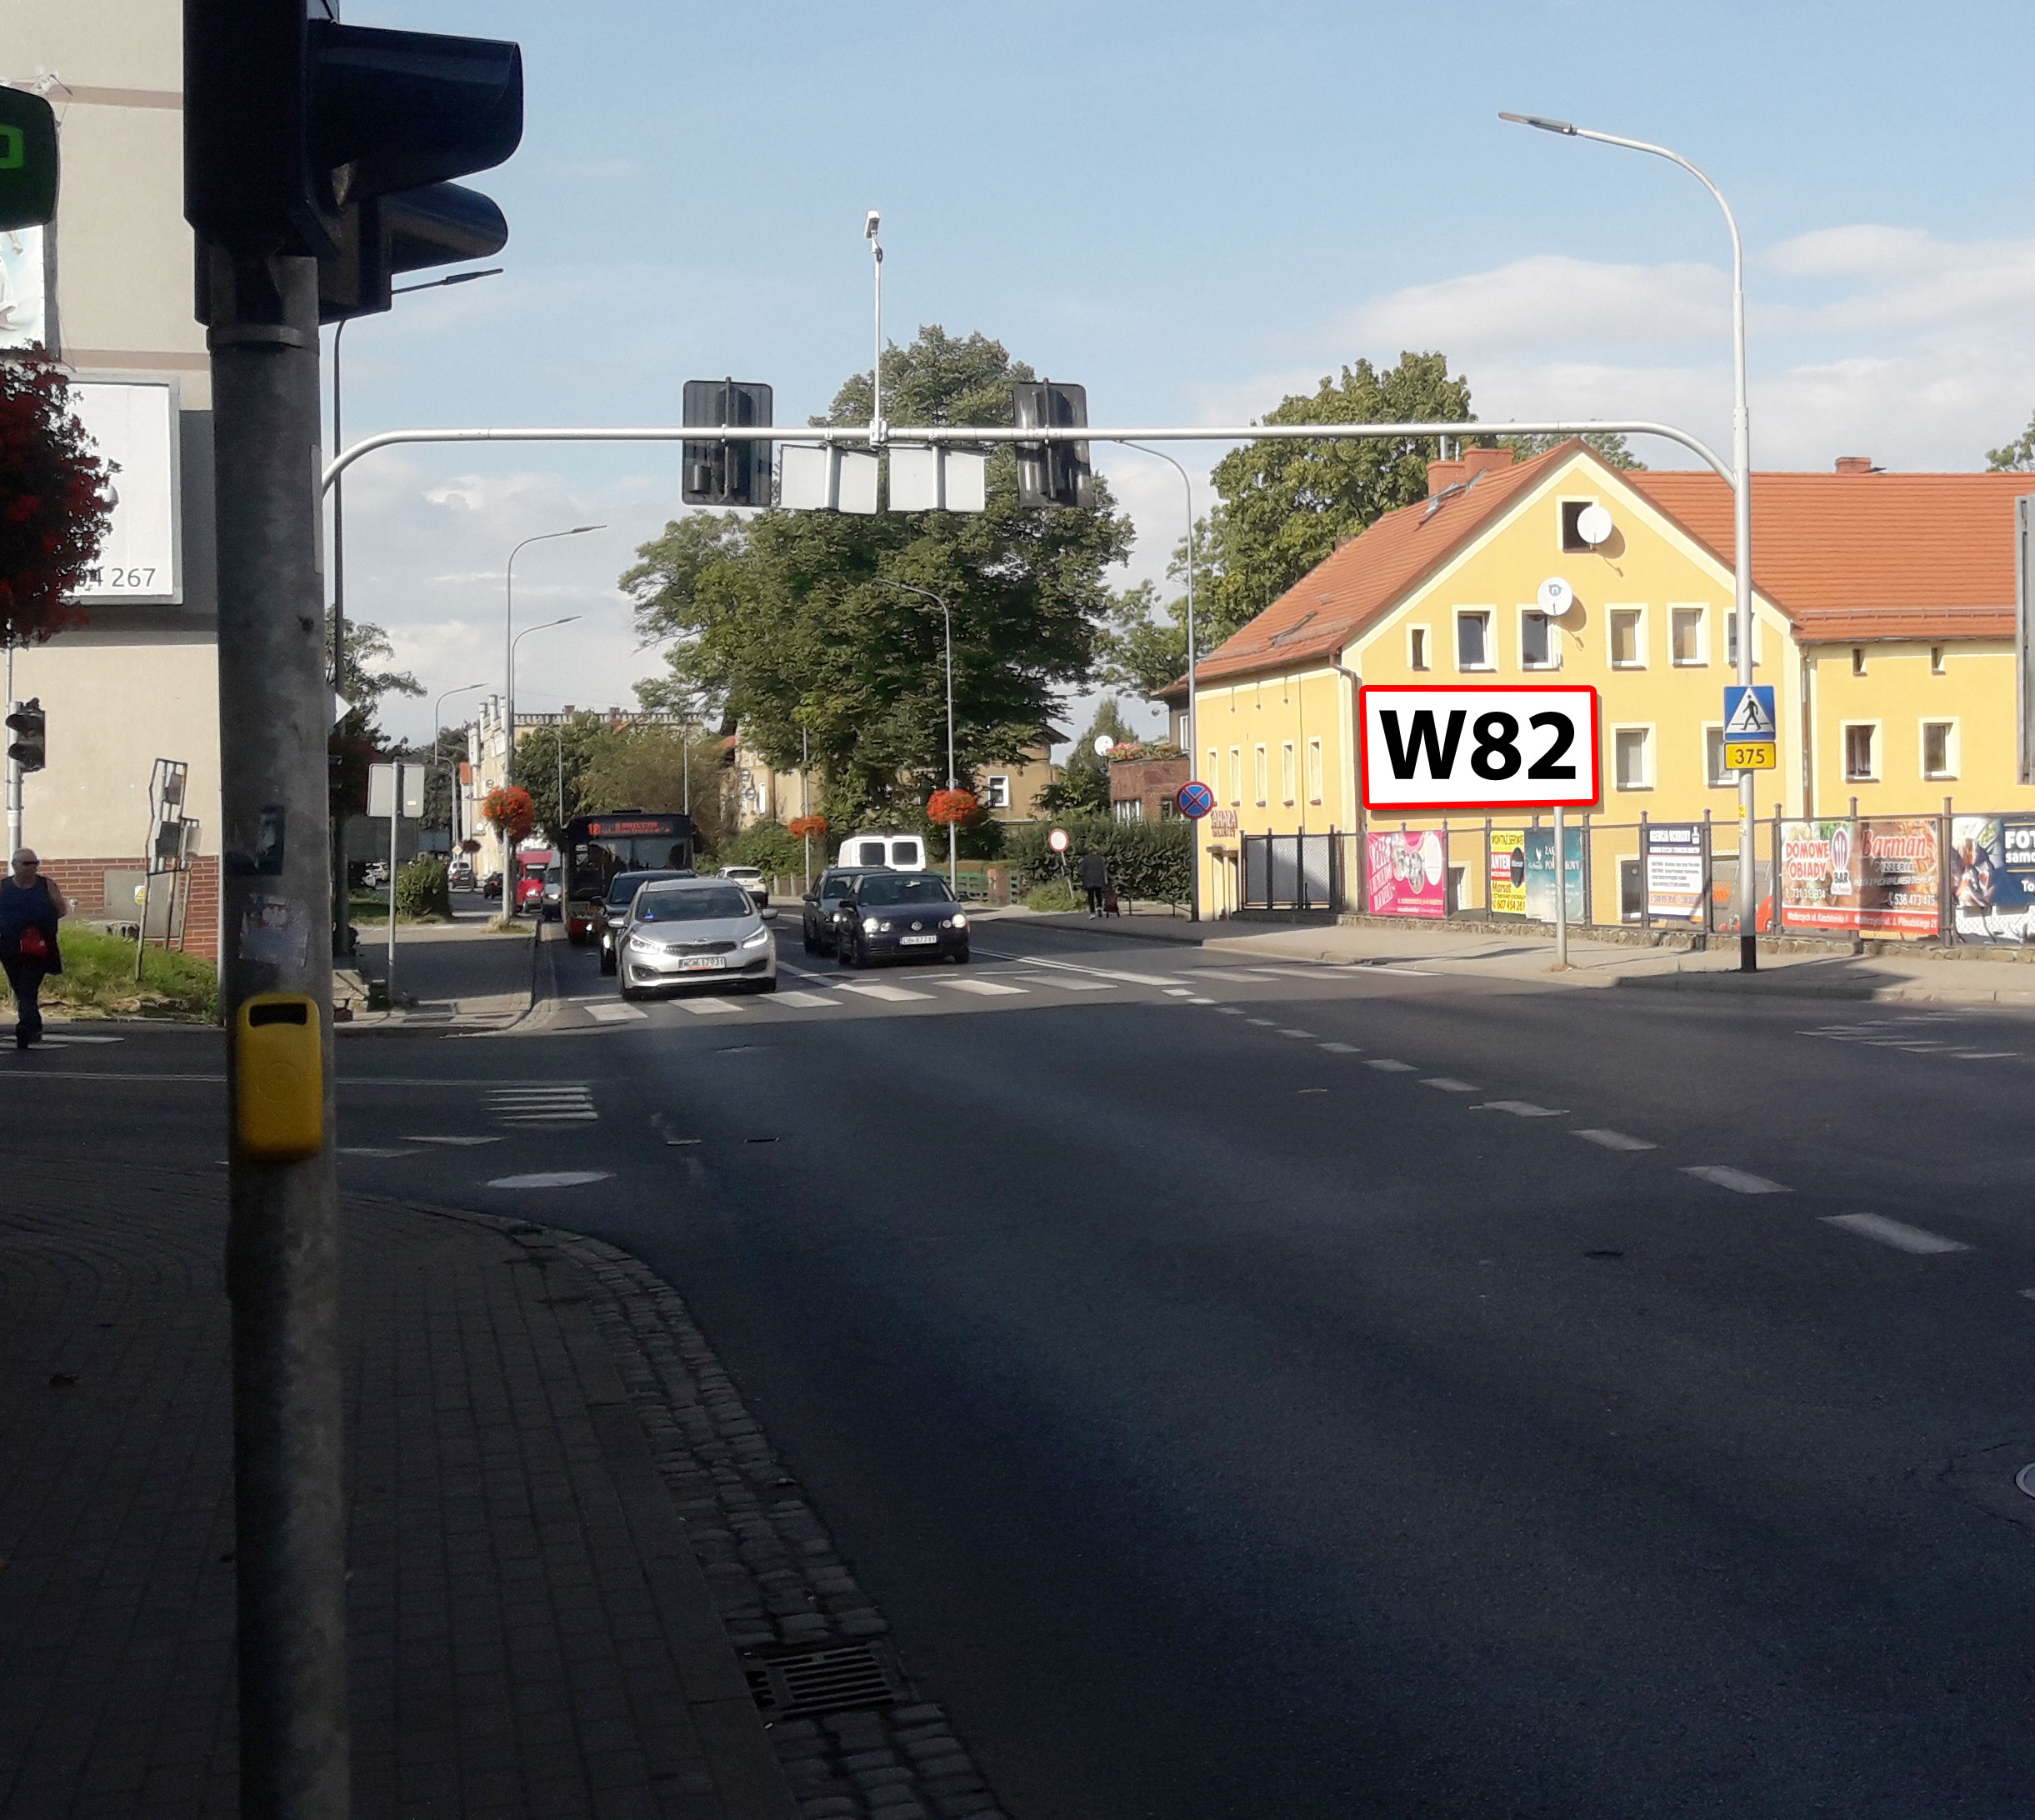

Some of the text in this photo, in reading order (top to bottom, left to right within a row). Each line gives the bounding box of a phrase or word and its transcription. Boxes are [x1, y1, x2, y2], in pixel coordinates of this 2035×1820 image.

[112, 568, 156, 587] 267
[1735, 749, 1765, 764] 375
[588, 822, 601, 835] 18
[1786, 842, 1829, 858] DOMOWE
[1862, 830, 1928, 858] Barman
[1789, 862, 1827, 879] OBIADY
[1834, 872, 1848, 883] BAR
